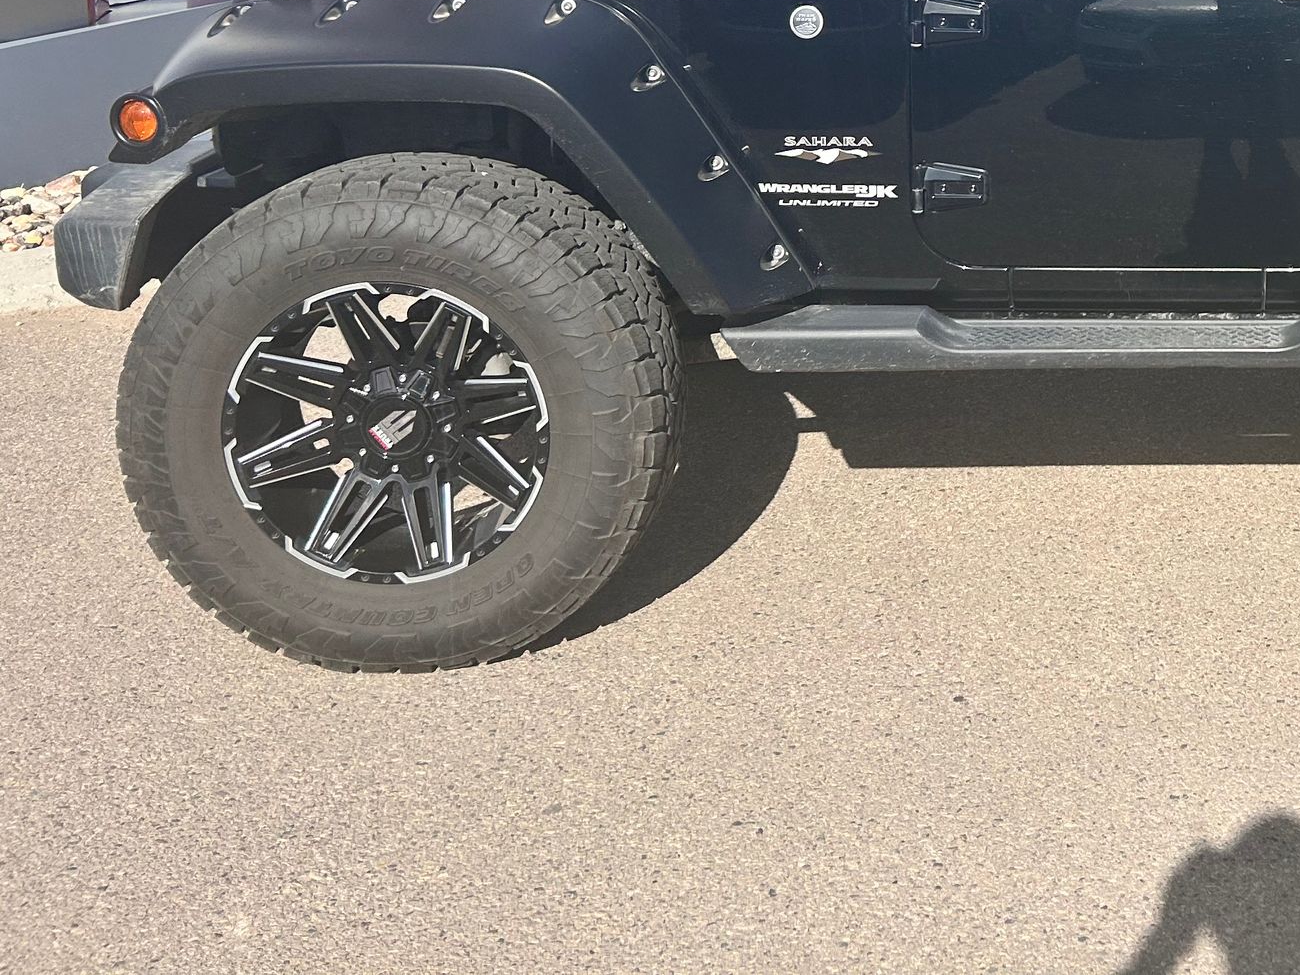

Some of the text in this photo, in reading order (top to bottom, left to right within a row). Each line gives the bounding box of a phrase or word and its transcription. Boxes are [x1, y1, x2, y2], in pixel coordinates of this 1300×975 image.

[784, 135, 874, 147] SAHARA
[778, 199, 879, 208] UNLIMITED
[283, 245, 396, 282] TOYO
[444, 551, 539, 618] OPEN
